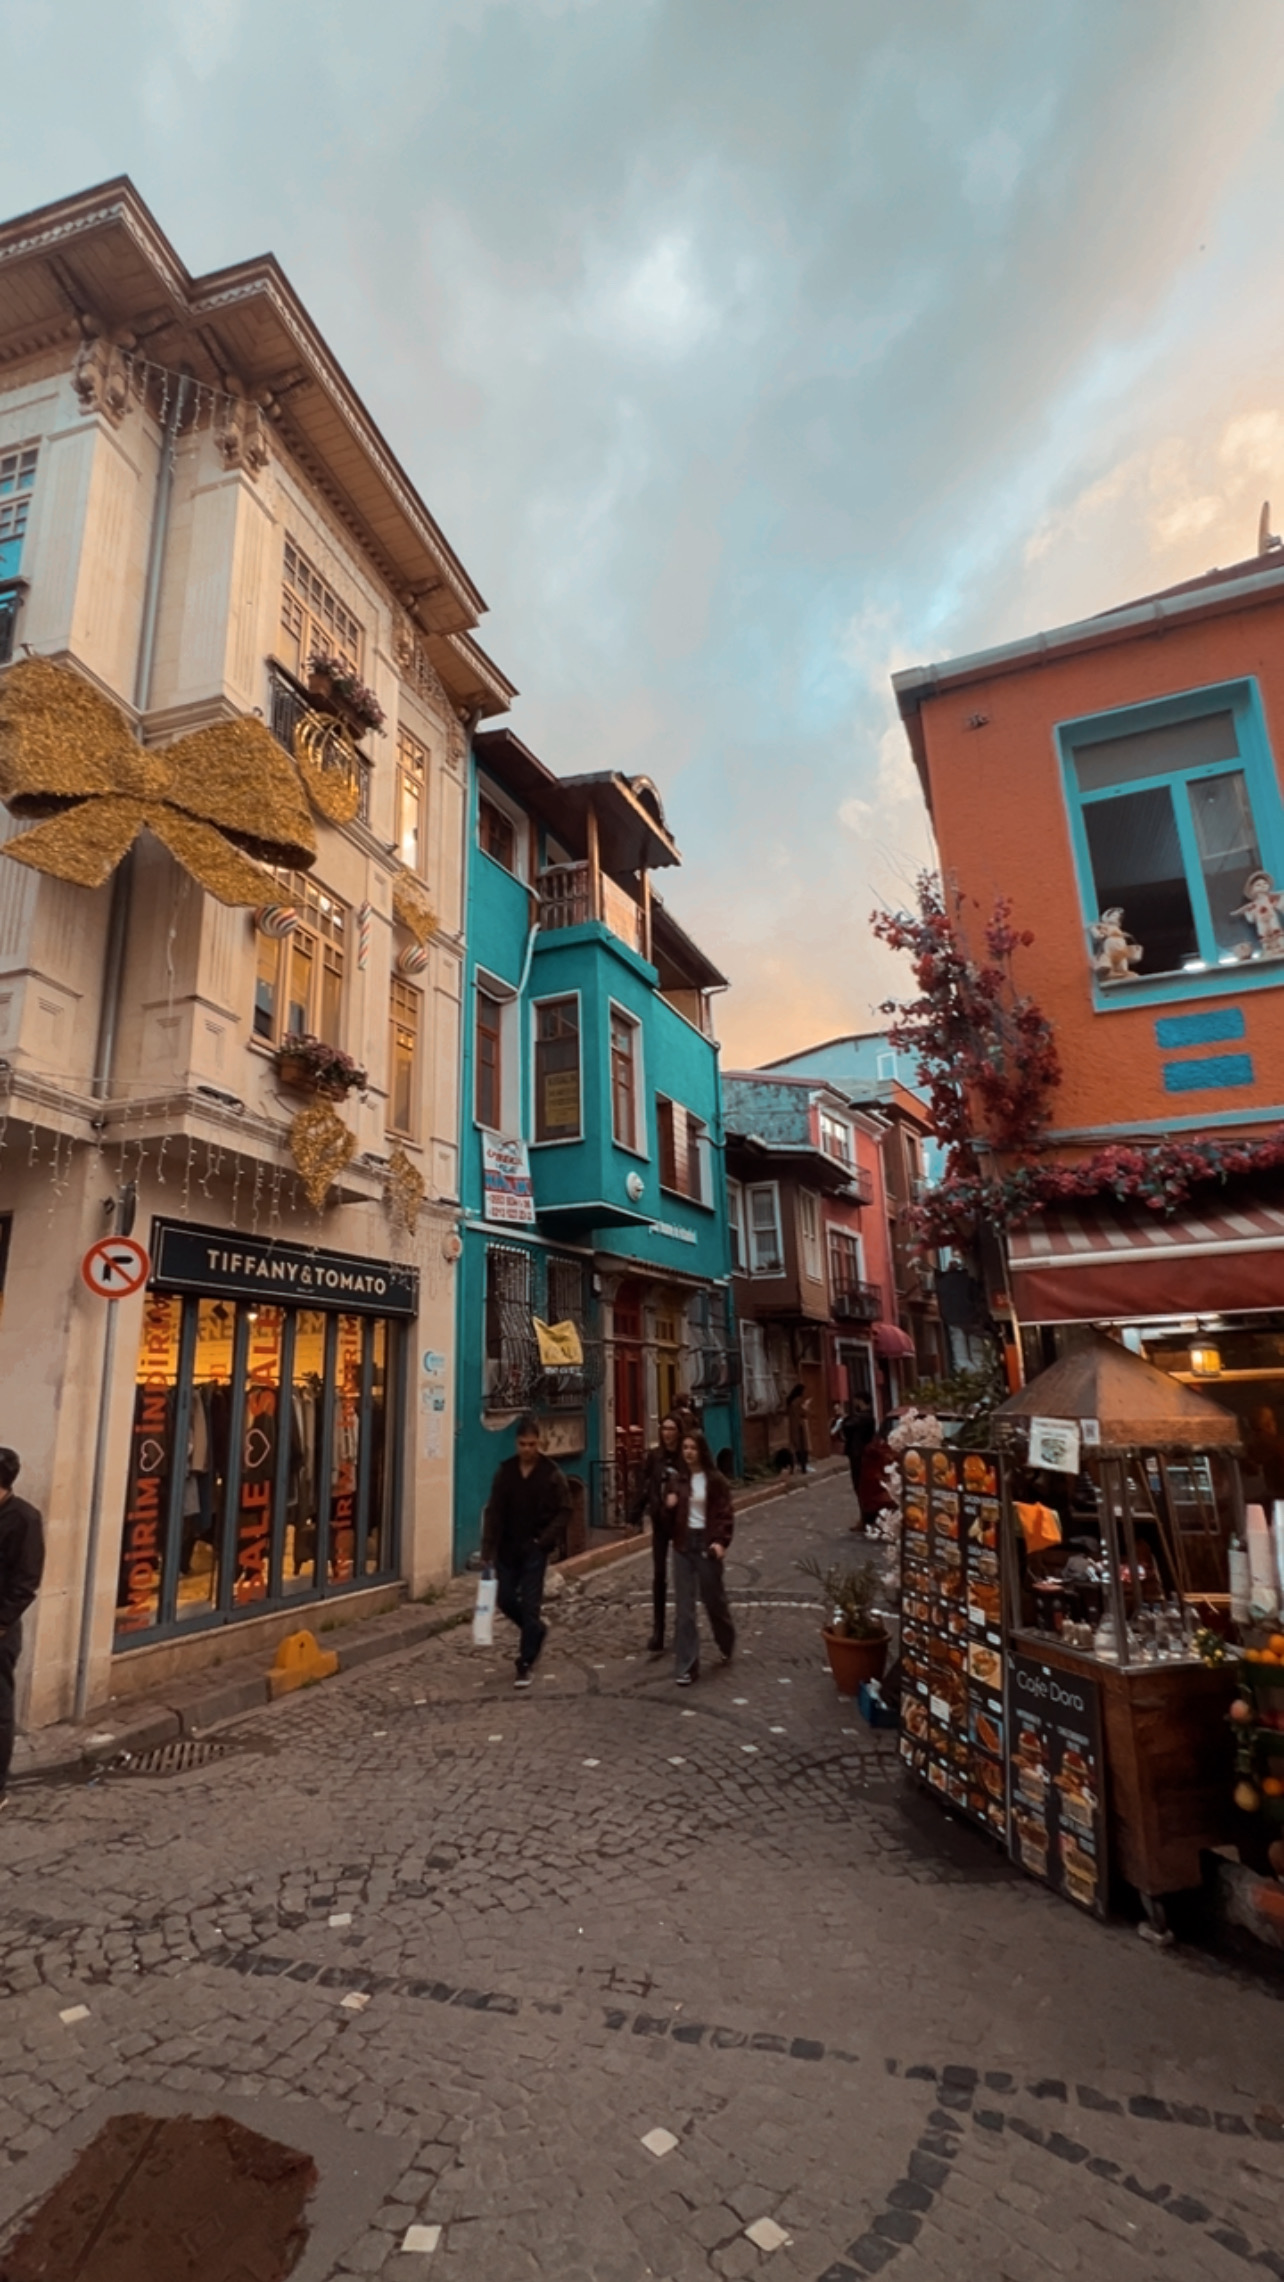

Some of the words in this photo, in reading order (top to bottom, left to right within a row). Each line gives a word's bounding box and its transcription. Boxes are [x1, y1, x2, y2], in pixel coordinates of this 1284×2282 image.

[207, 1249, 386, 1295] TIFFANY&TOMATO
[248, 1306, 282, 1416] SALE
[235, 1480, 271, 1605] SALE
[1050, 1682, 1085, 1712] Dora
